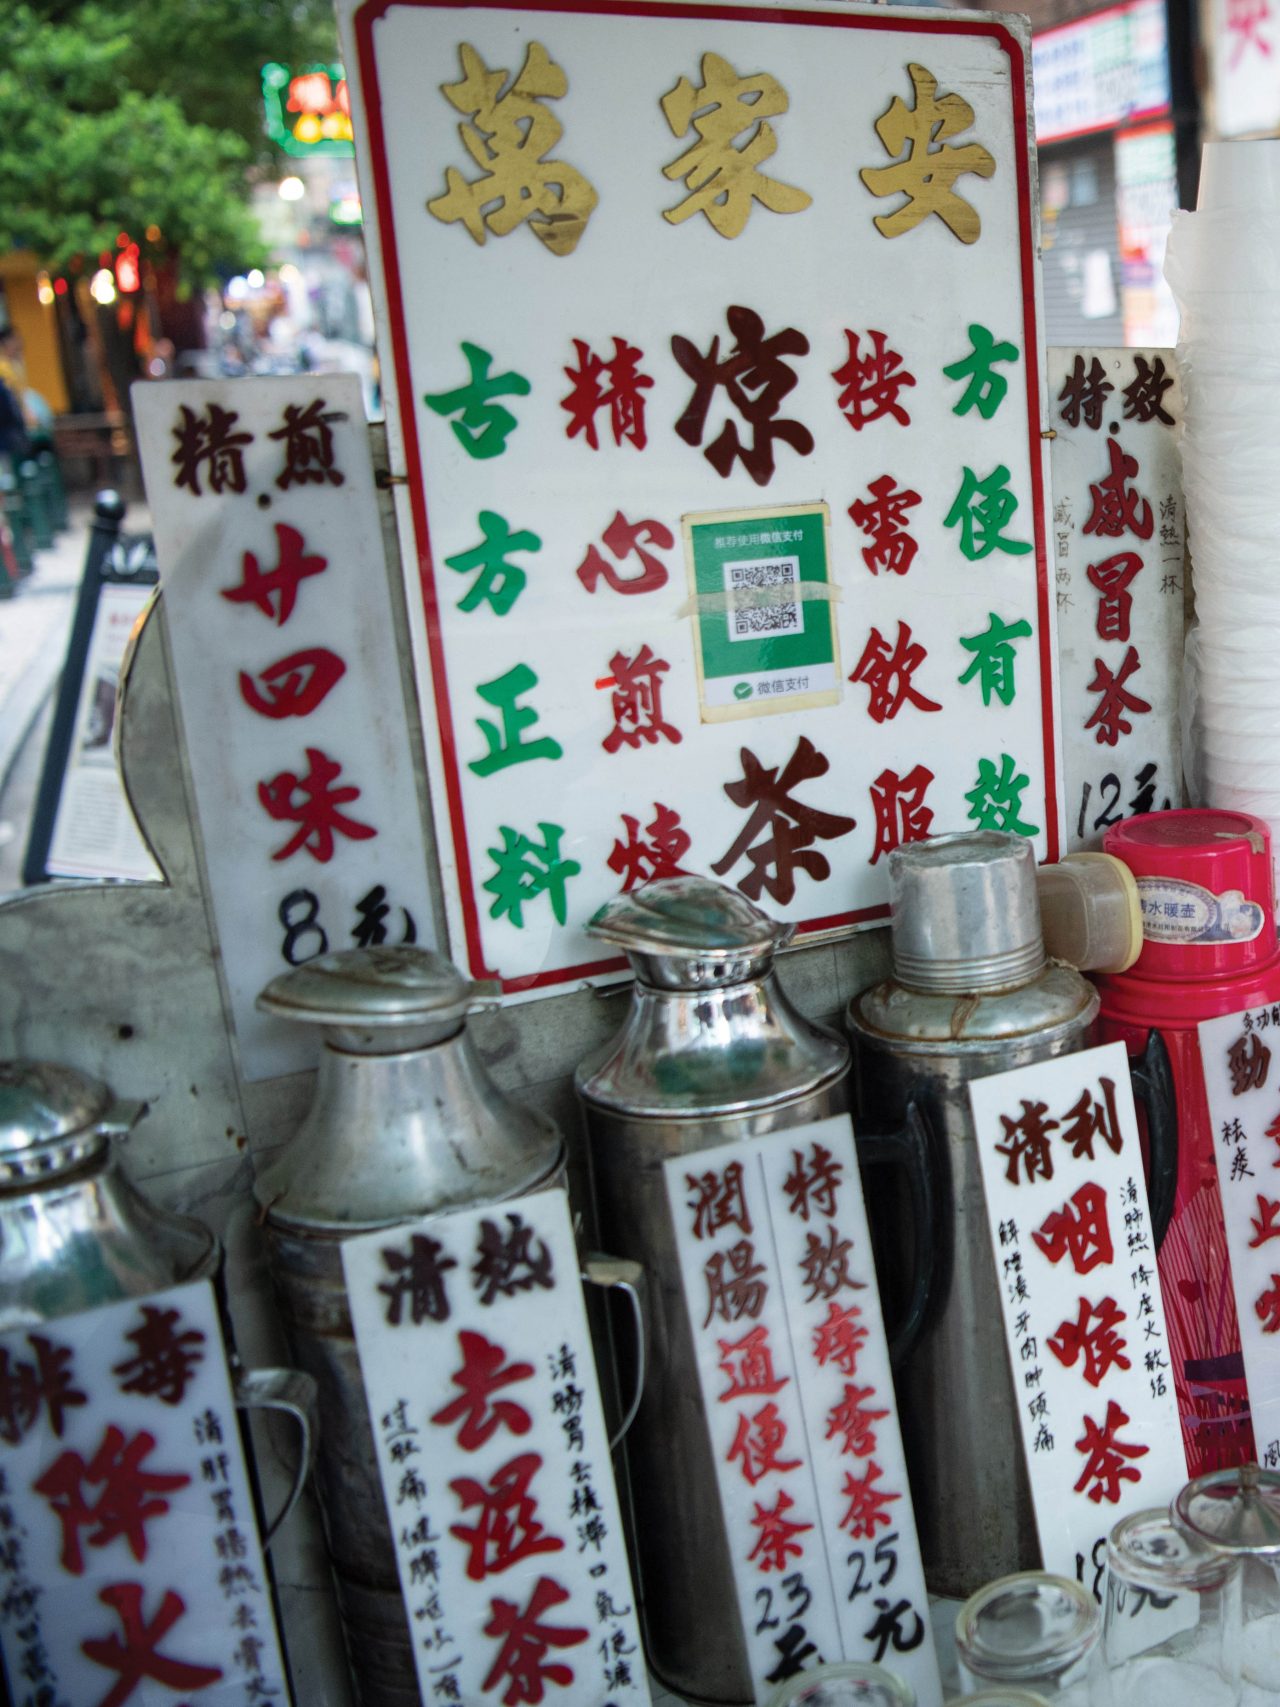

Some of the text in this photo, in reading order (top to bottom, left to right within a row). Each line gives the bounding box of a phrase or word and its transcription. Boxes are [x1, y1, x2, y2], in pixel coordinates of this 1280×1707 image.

[427, 40, 996, 256] 萬家安
[170, 399, 352, 496] 精煎
[831, 329, 942, 865] 按需飲服
[1083, 437, 1155, 746] 感冒茶
[221, 523, 378, 864] 廿四味
[425, 341, 580, 928] 古方正料
[758, 676, 810, 695] 微信支付
[995, 1077, 1124, 1186] 清利
[1031, 1181, 1149, 1504] 咽喉茶
